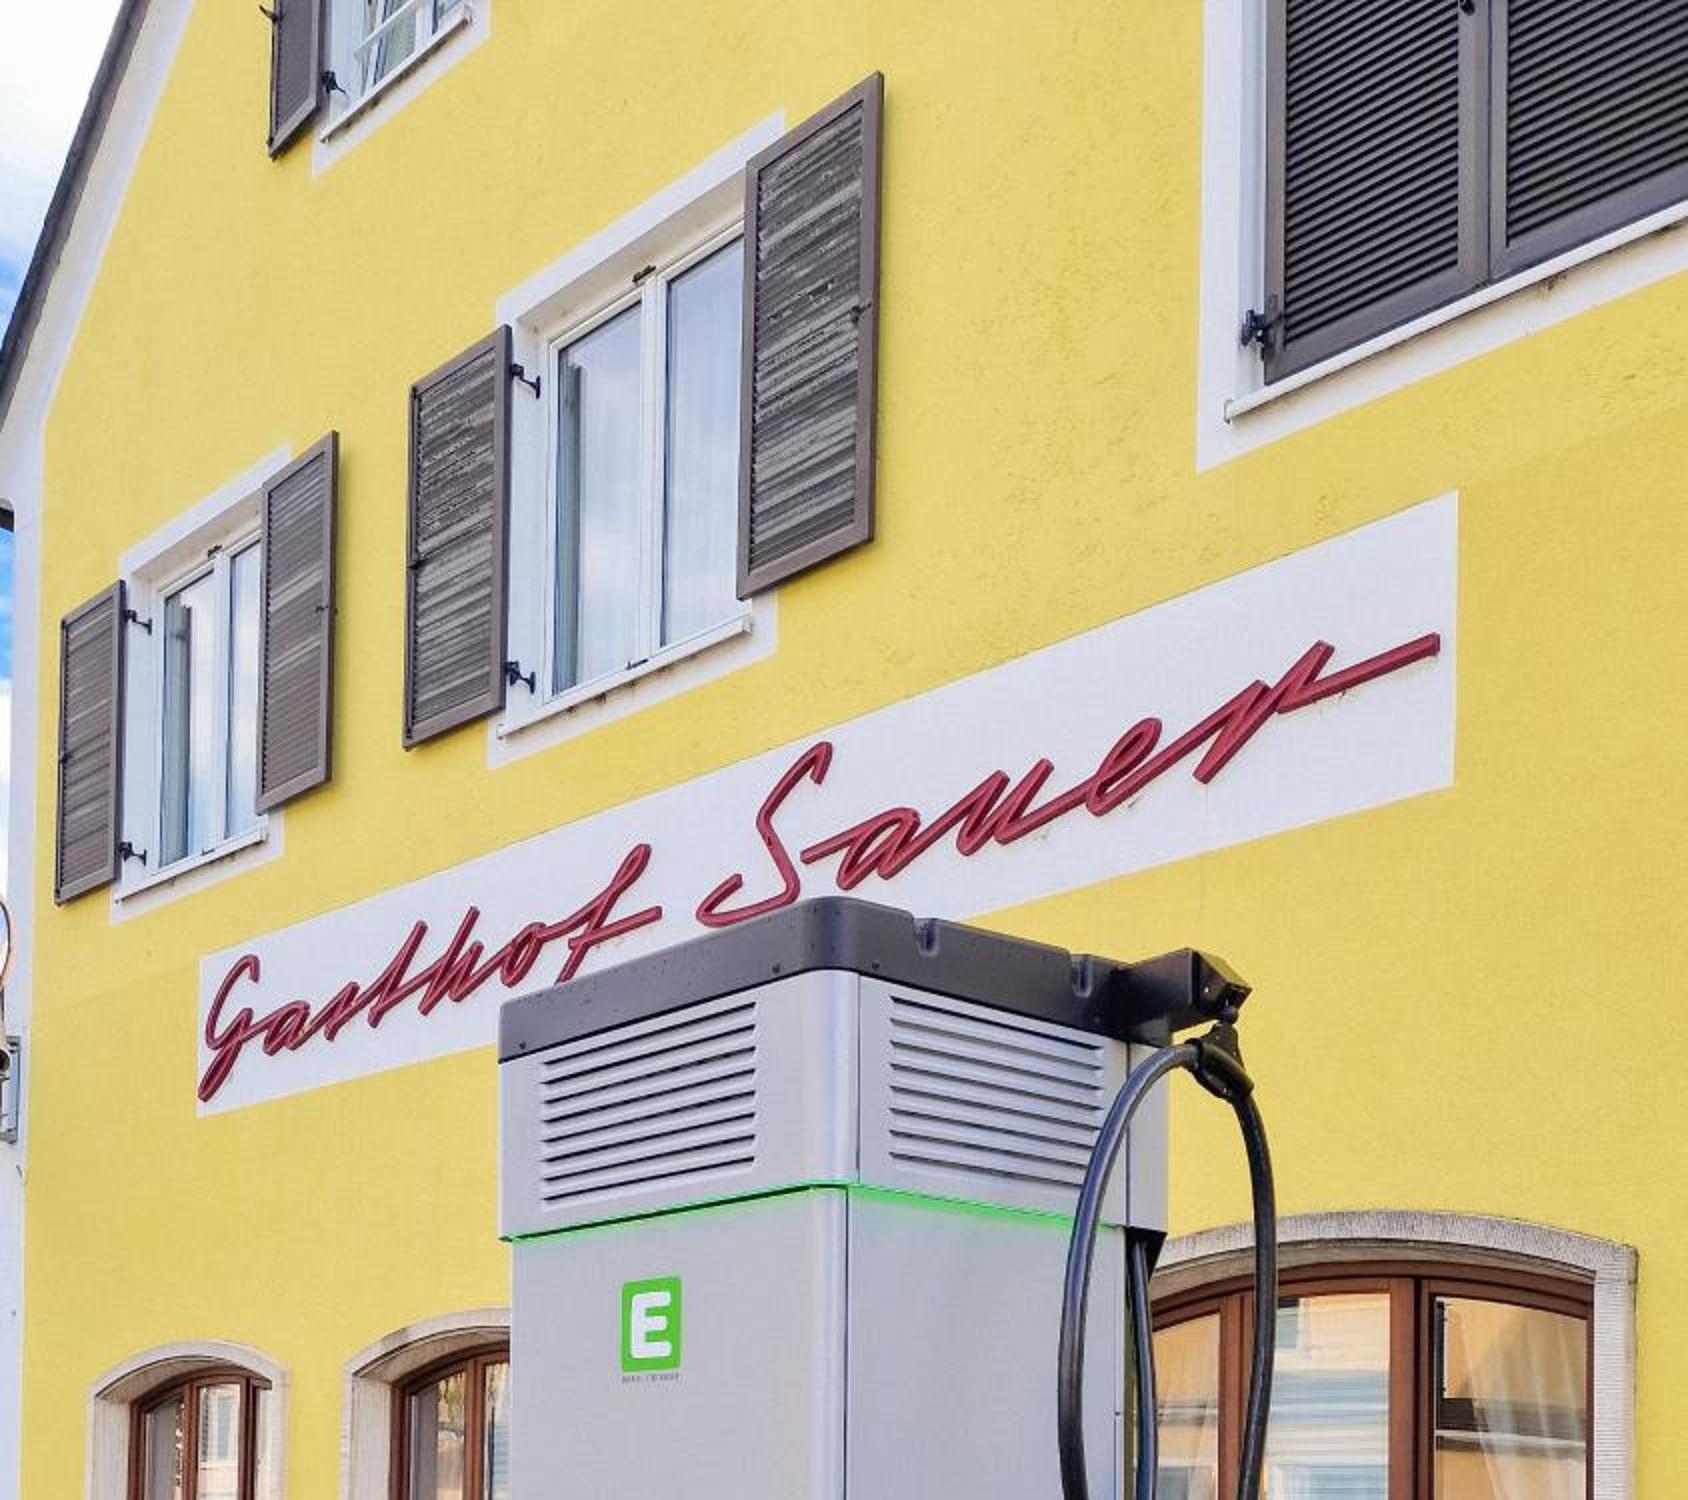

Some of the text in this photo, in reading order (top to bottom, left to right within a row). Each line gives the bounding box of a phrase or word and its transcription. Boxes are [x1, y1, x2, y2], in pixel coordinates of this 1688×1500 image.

[197, 634, 1442, 1103] Gasthof Sauer
[631, 1290, 672, 1359] E
